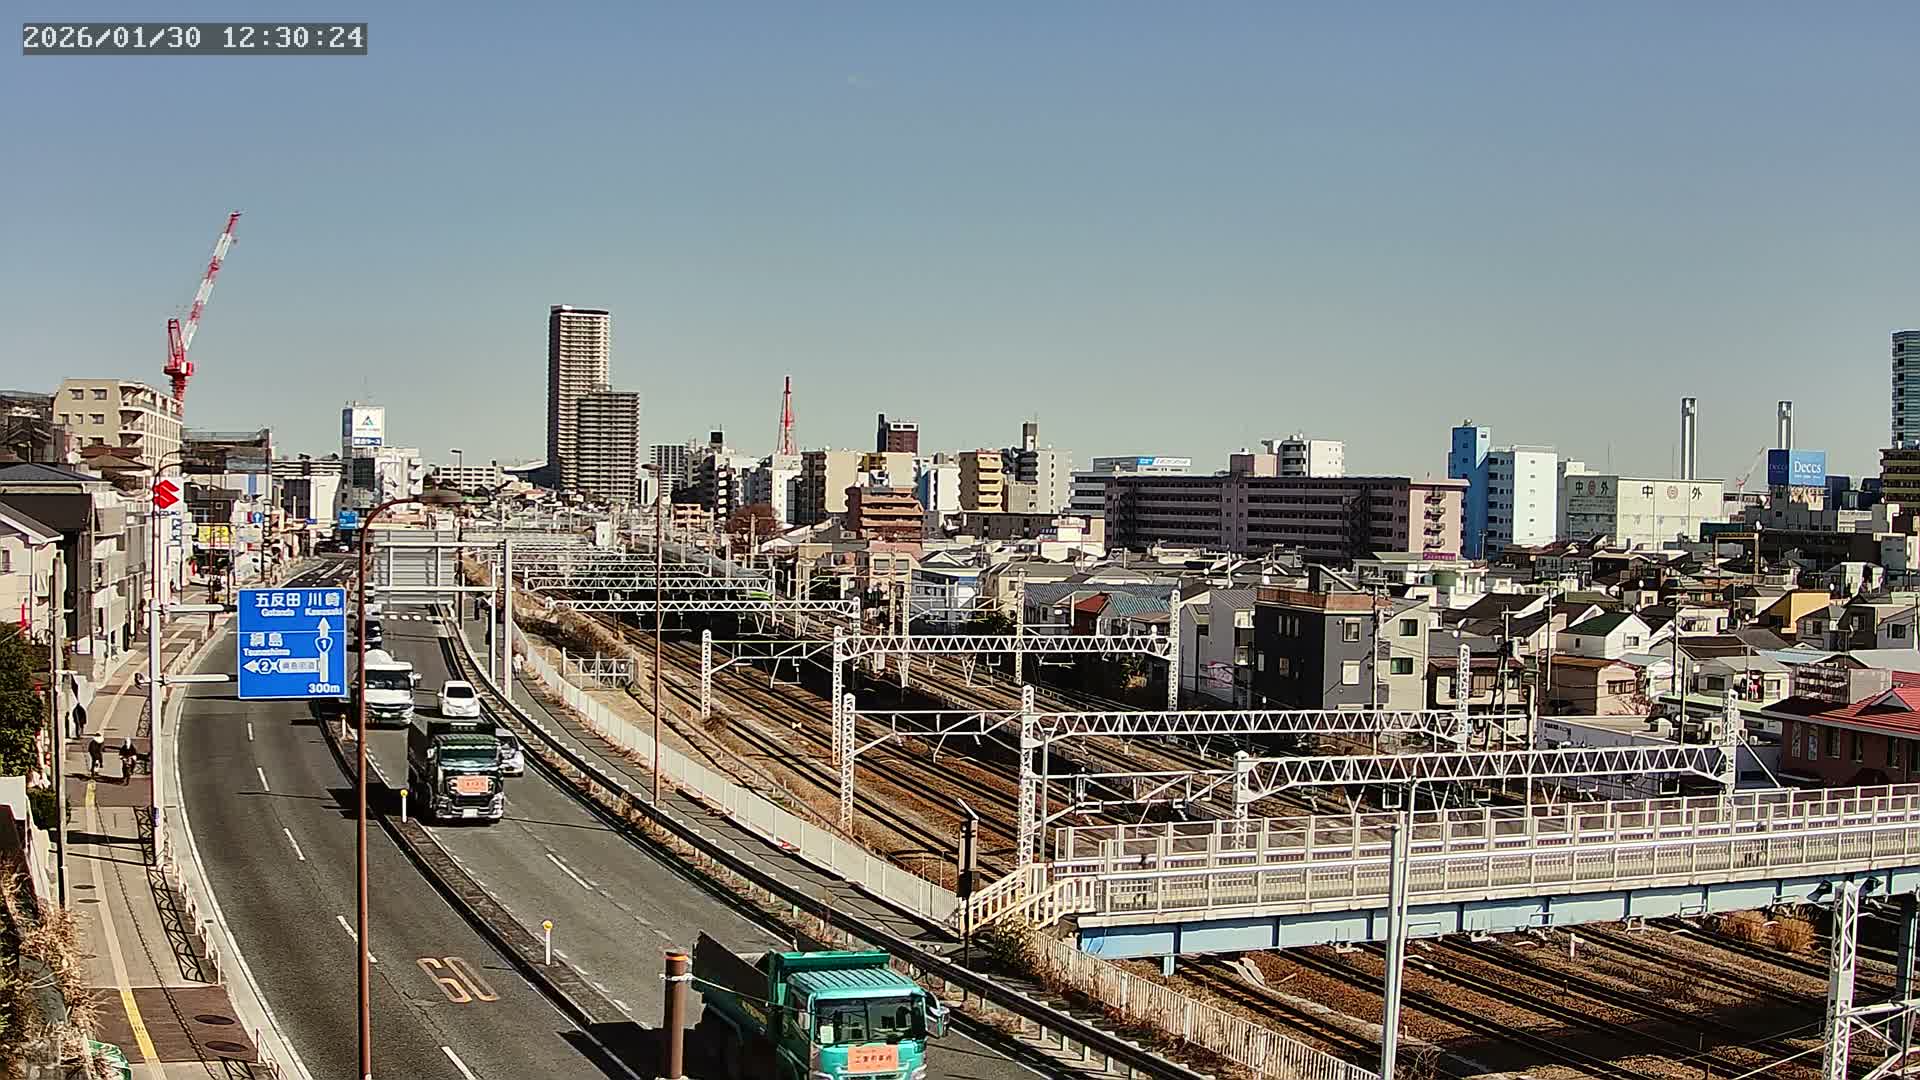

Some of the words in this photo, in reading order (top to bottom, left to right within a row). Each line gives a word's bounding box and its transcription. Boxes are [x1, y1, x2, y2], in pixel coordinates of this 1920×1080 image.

[1642, 485, 1653, 499] 中
[1691, 486, 1703, 500] 外
[254, 592, 301, 608] 五反田
[320, 639, 327, 649] 1
[261, 661, 269, 671] 2
[308, 683, 341, 694] 300m
[416, 956, 497, 1003] 60
